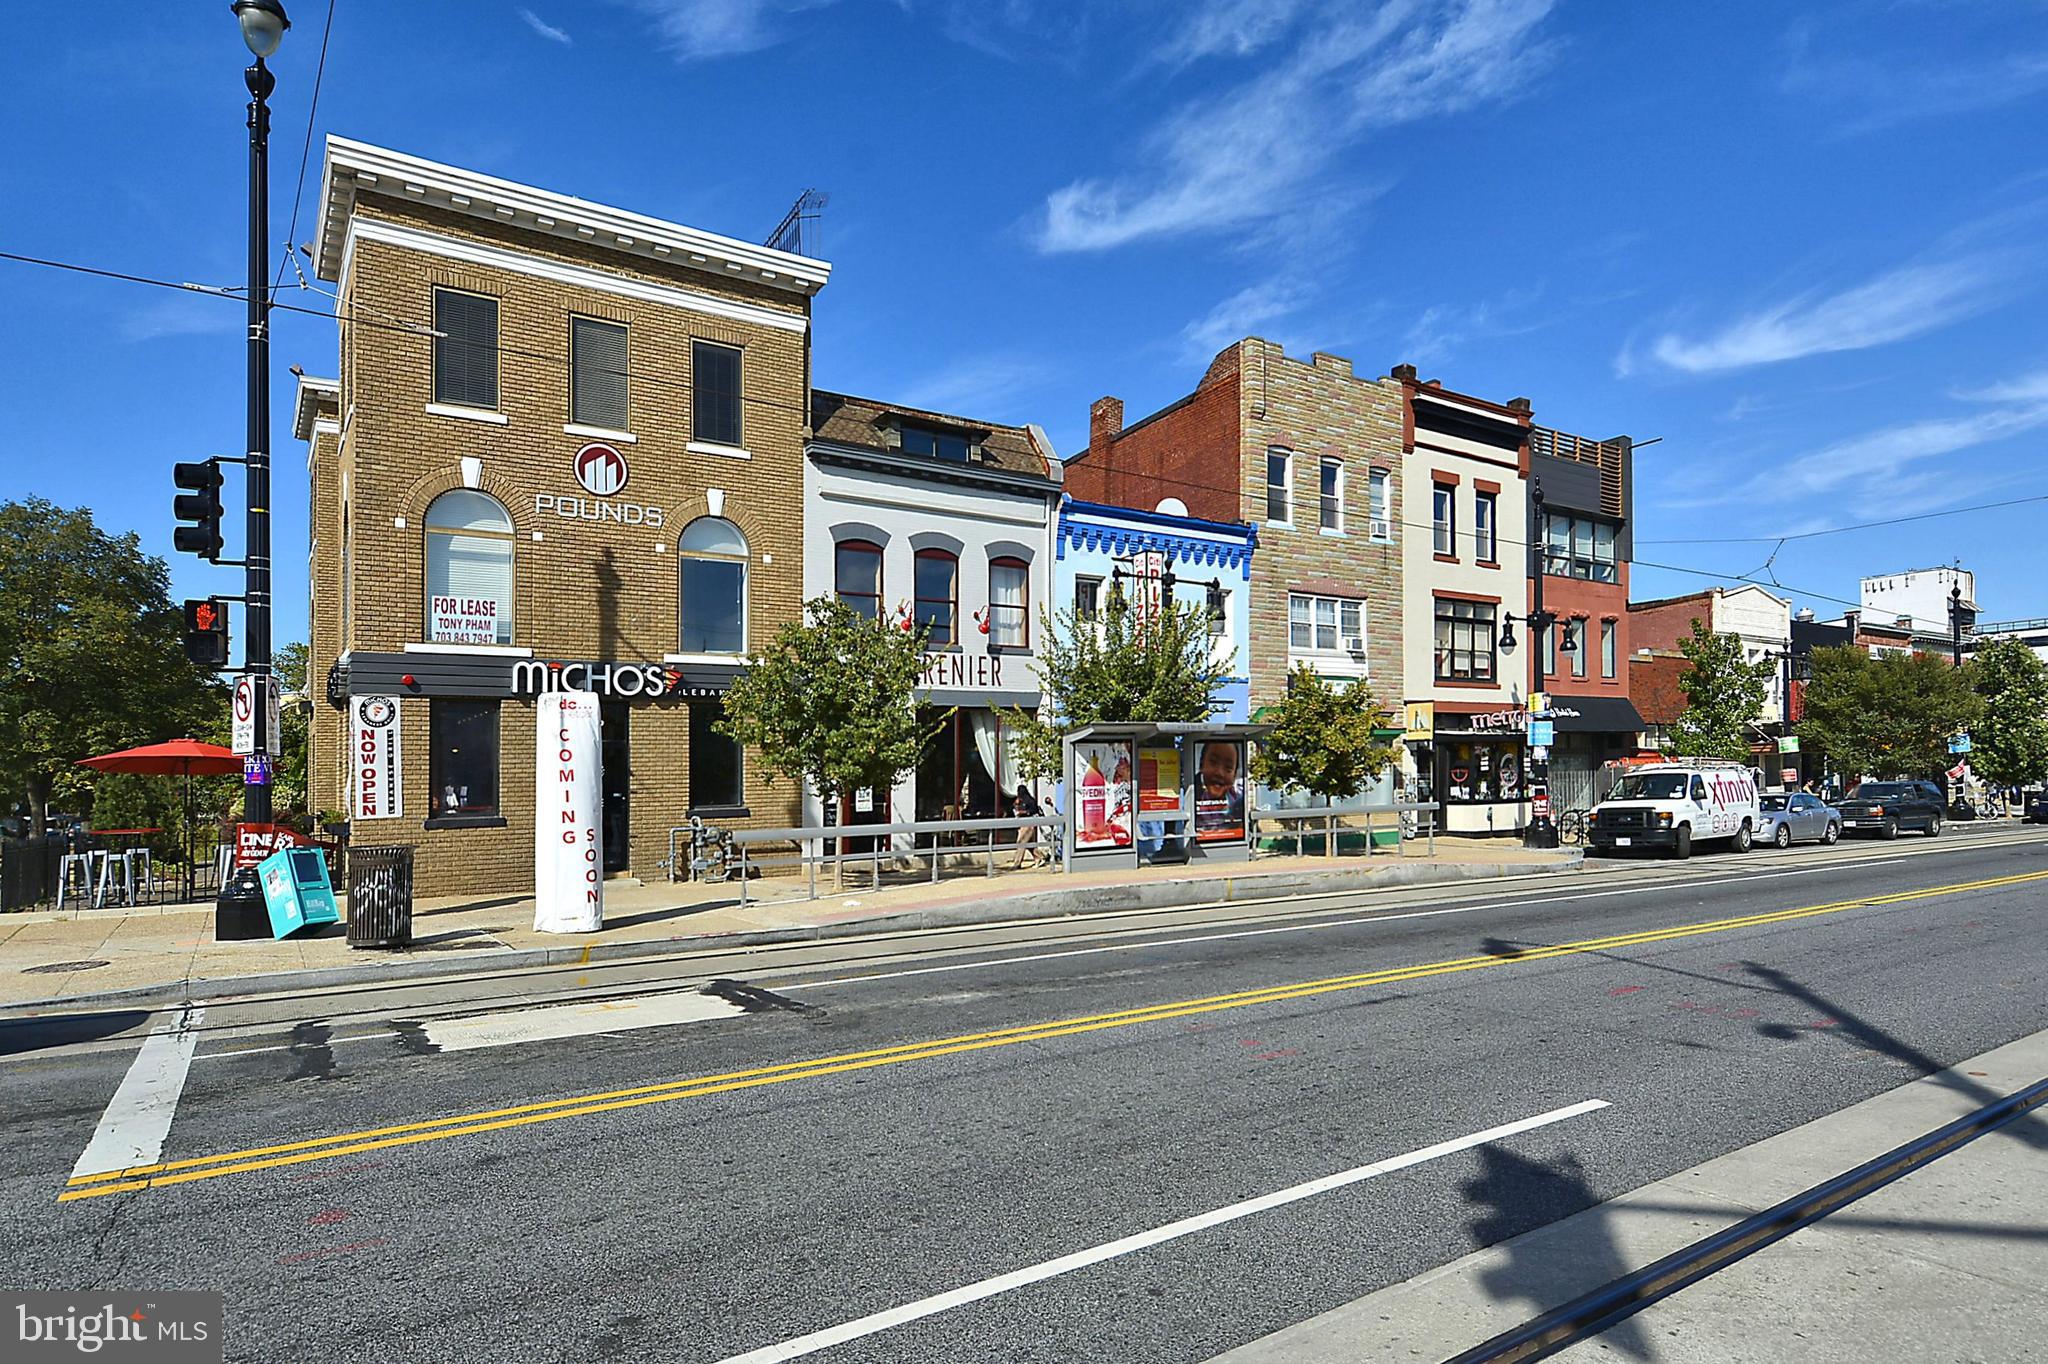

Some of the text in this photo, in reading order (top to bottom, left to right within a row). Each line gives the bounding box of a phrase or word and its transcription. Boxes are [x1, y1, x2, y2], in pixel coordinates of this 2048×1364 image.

[535, 494, 663, 527] POUNDS
[434, 598, 496, 617] FOR LEASE
[438, 618, 491, 631] TONY PHAM
[435, 632, 493, 645] 703 843 7947
[361, 729, 377, 816] NOW OPEN
[559, 728, 577, 844] COMING
[1708, 773, 1754, 812] xfinity
[585, 828, 599, 903] SOON
